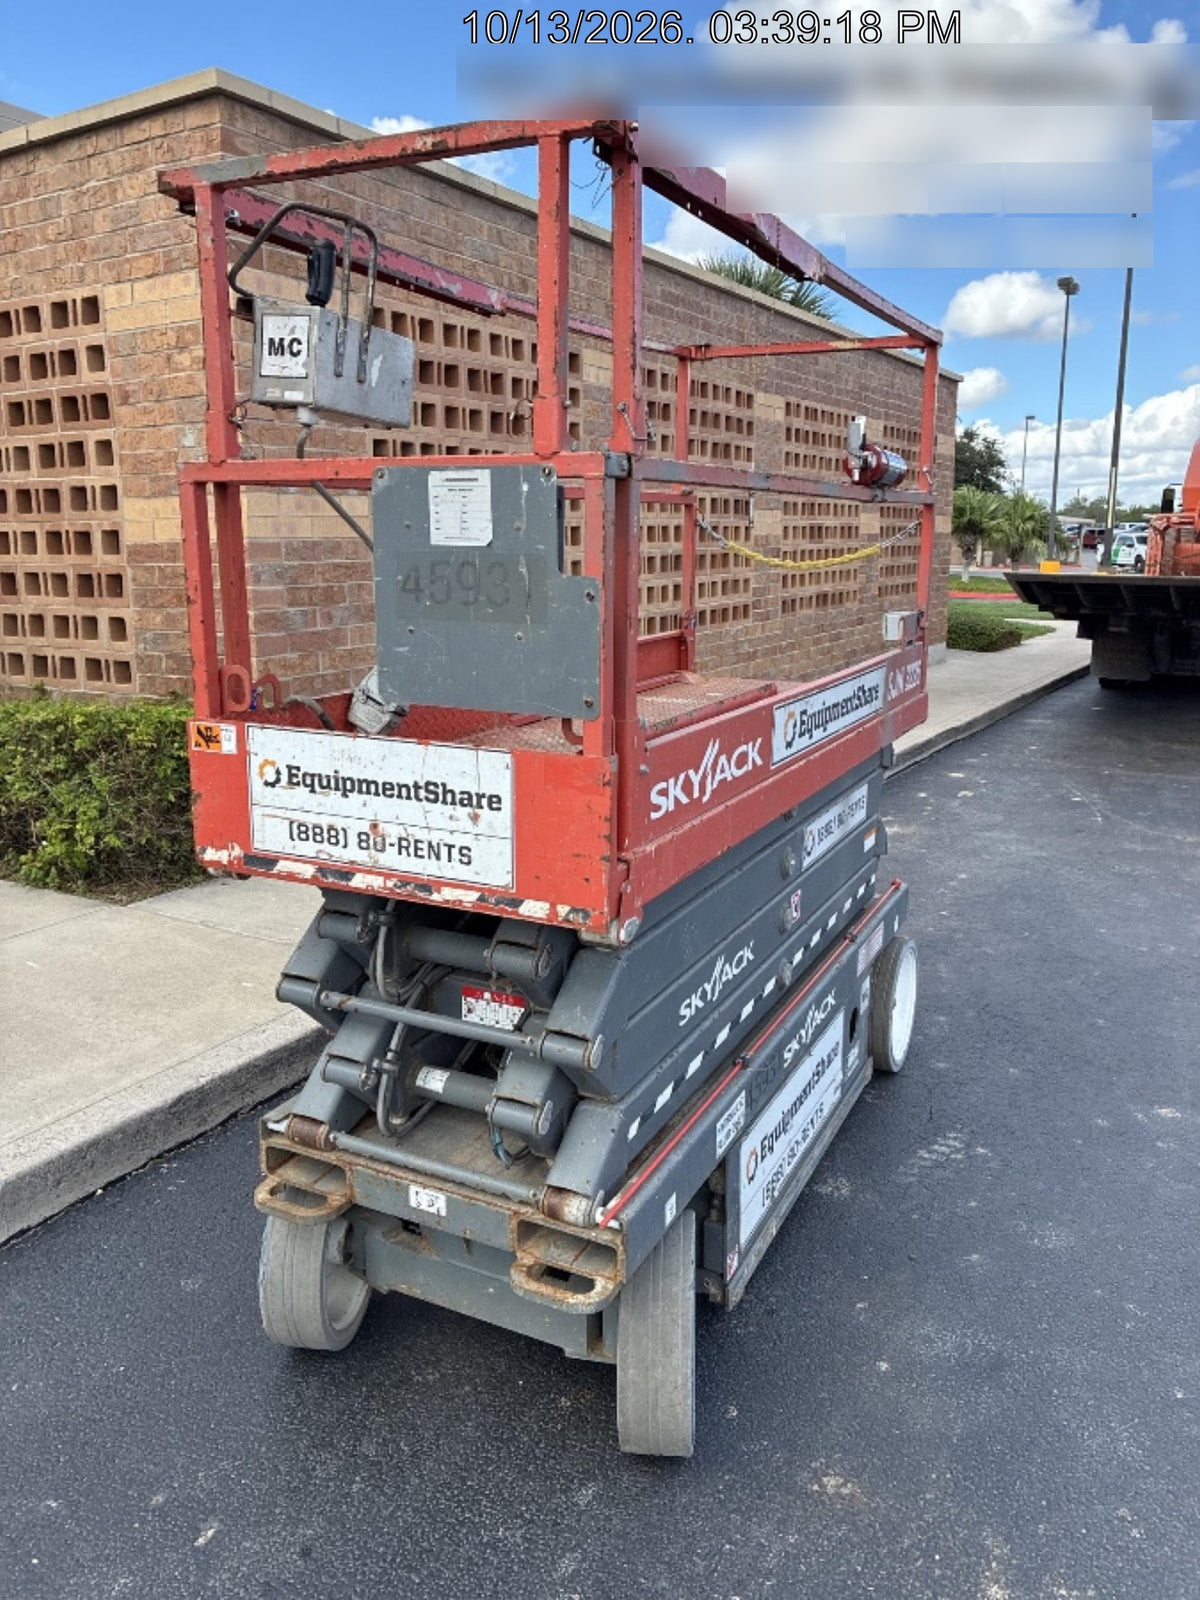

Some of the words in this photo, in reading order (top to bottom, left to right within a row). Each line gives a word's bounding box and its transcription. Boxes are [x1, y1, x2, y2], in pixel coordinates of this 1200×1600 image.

[267, 337, 303, 358] MC
[798, 683, 880, 741] EquipmentShare
[286, 764, 503, 812] EquipmentShare
[650, 737, 763, 820] SKYJACK
[289, 820, 348, 849] (888)
[679, 940, 755, 1027] SKYJACK
[783, 987, 837, 1068] SKYJACK
[760, 1040, 840, 1163] EquipmentShare
